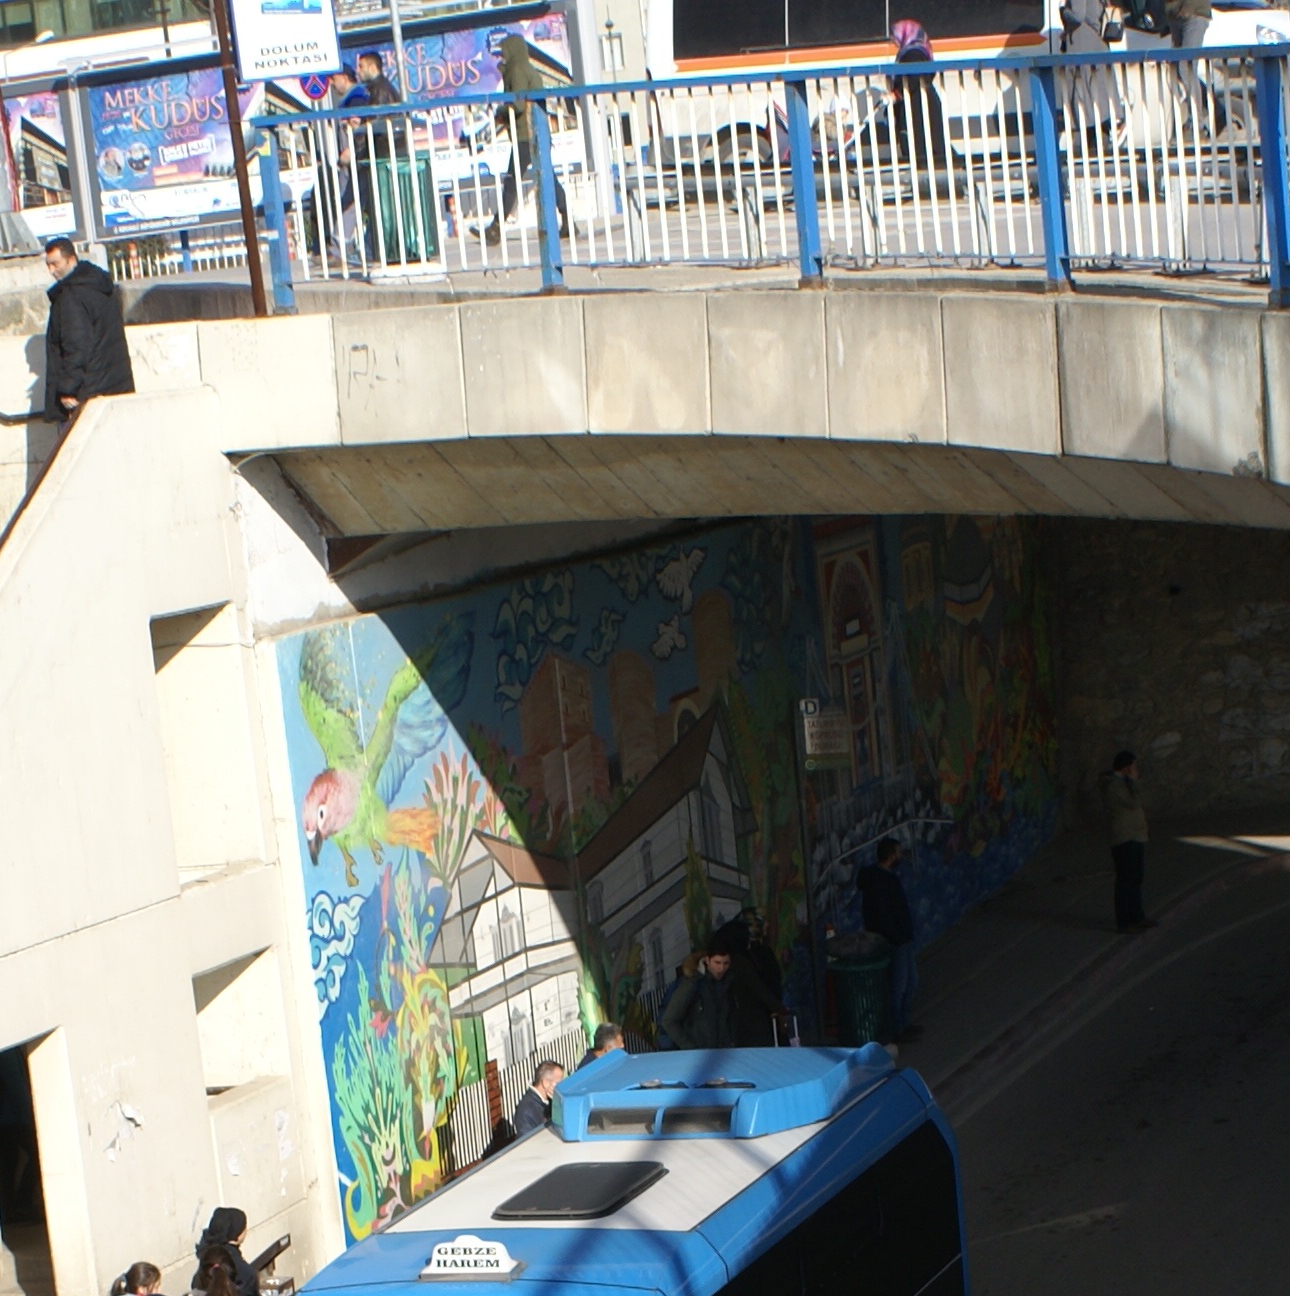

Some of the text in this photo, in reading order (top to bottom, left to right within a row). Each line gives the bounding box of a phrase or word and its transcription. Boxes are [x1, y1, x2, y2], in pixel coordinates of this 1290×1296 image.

[260, 42, 319, 57] DOLUM
[254, 53, 328, 70] NOKTASI
[103, 81, 172, 110] MEKKE
[437, 1247, 497, 1256] GEBZE
[436, 1259, 500, 1268] HAREM
